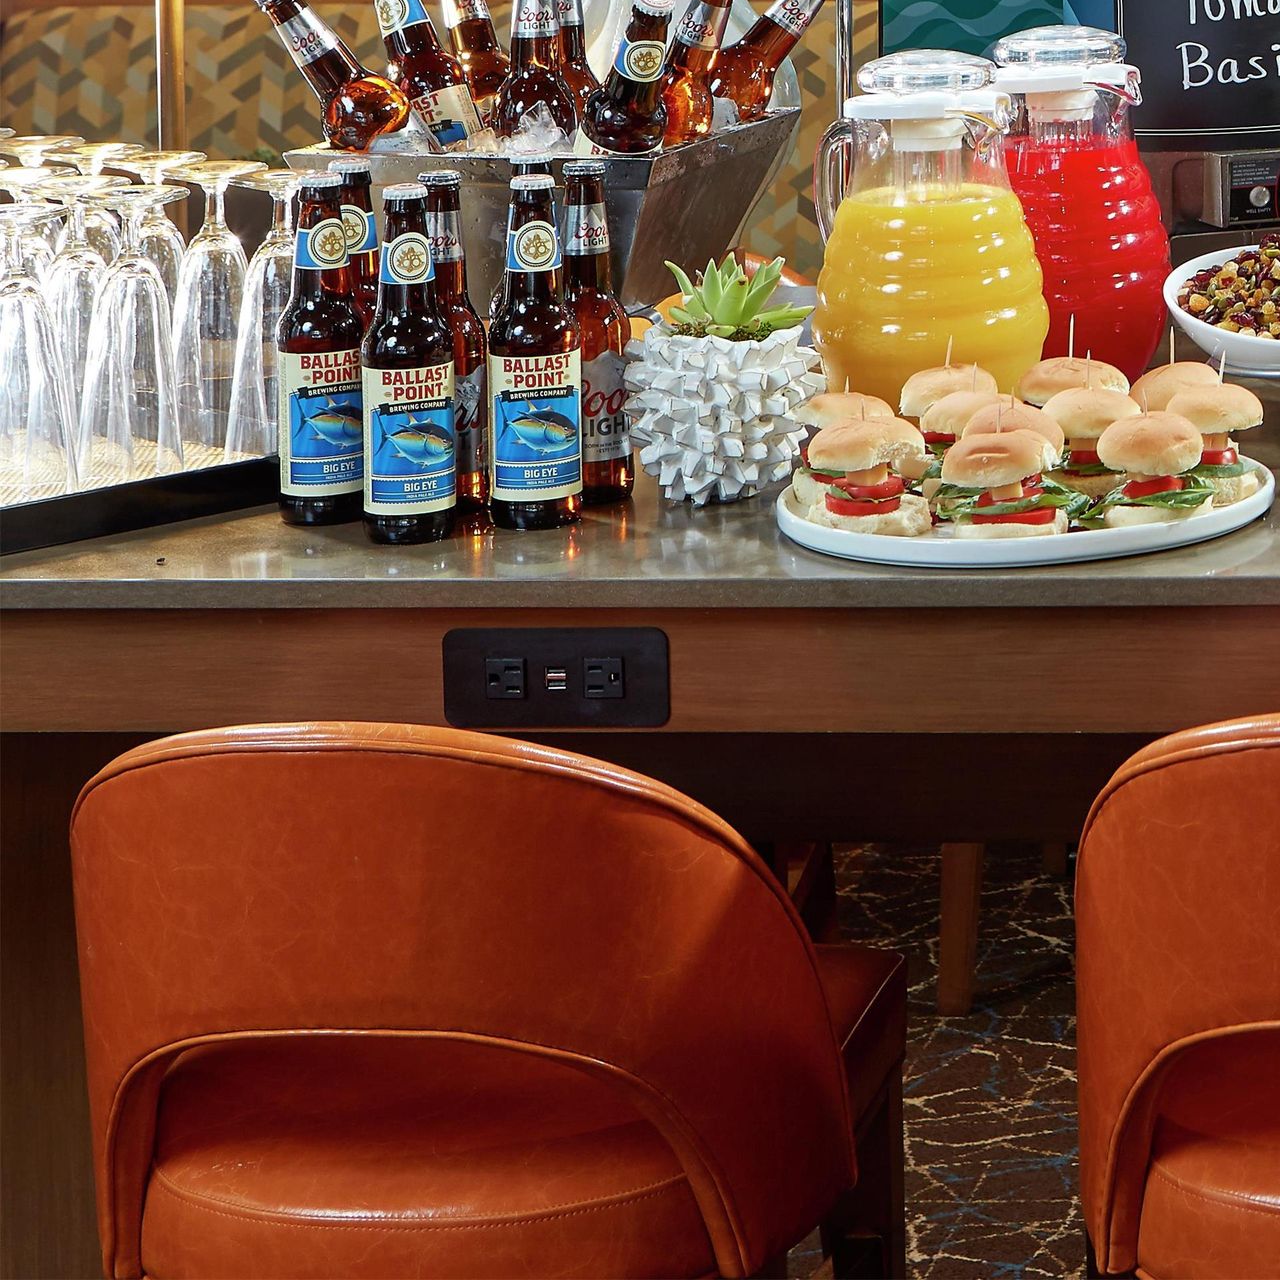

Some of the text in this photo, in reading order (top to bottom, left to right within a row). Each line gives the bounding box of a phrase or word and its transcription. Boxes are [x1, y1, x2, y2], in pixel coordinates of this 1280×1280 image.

[518, 6, 555, 22] Coors
[523, 21, 550, 30] LIGHT
[682, 12, 713, 36] Coors
[681, 28, 705, 42] LIGHT
[430, 247, 452, 256] GHT
[300, 351, 360, 370] BALLAS
[503, 354, 571, 373] BALLAST
[312, 365, 362, 385] POINT
[382, 365, 449, 386] BALLAST
[513, 371, 565, 388] POINT
[308, 384, 338, 397] BREWING
[393, 383, 444, 401] POINT
[510, 389, 568, 400] BREWING COMPANY
[389, 401, 446, 413] BREWING COMPANY
[323, 461, 355, 474] BIG EYE
[524, 467, 558, 479] BIG EYE
[404, 480, 438, 492] BIG EYE
